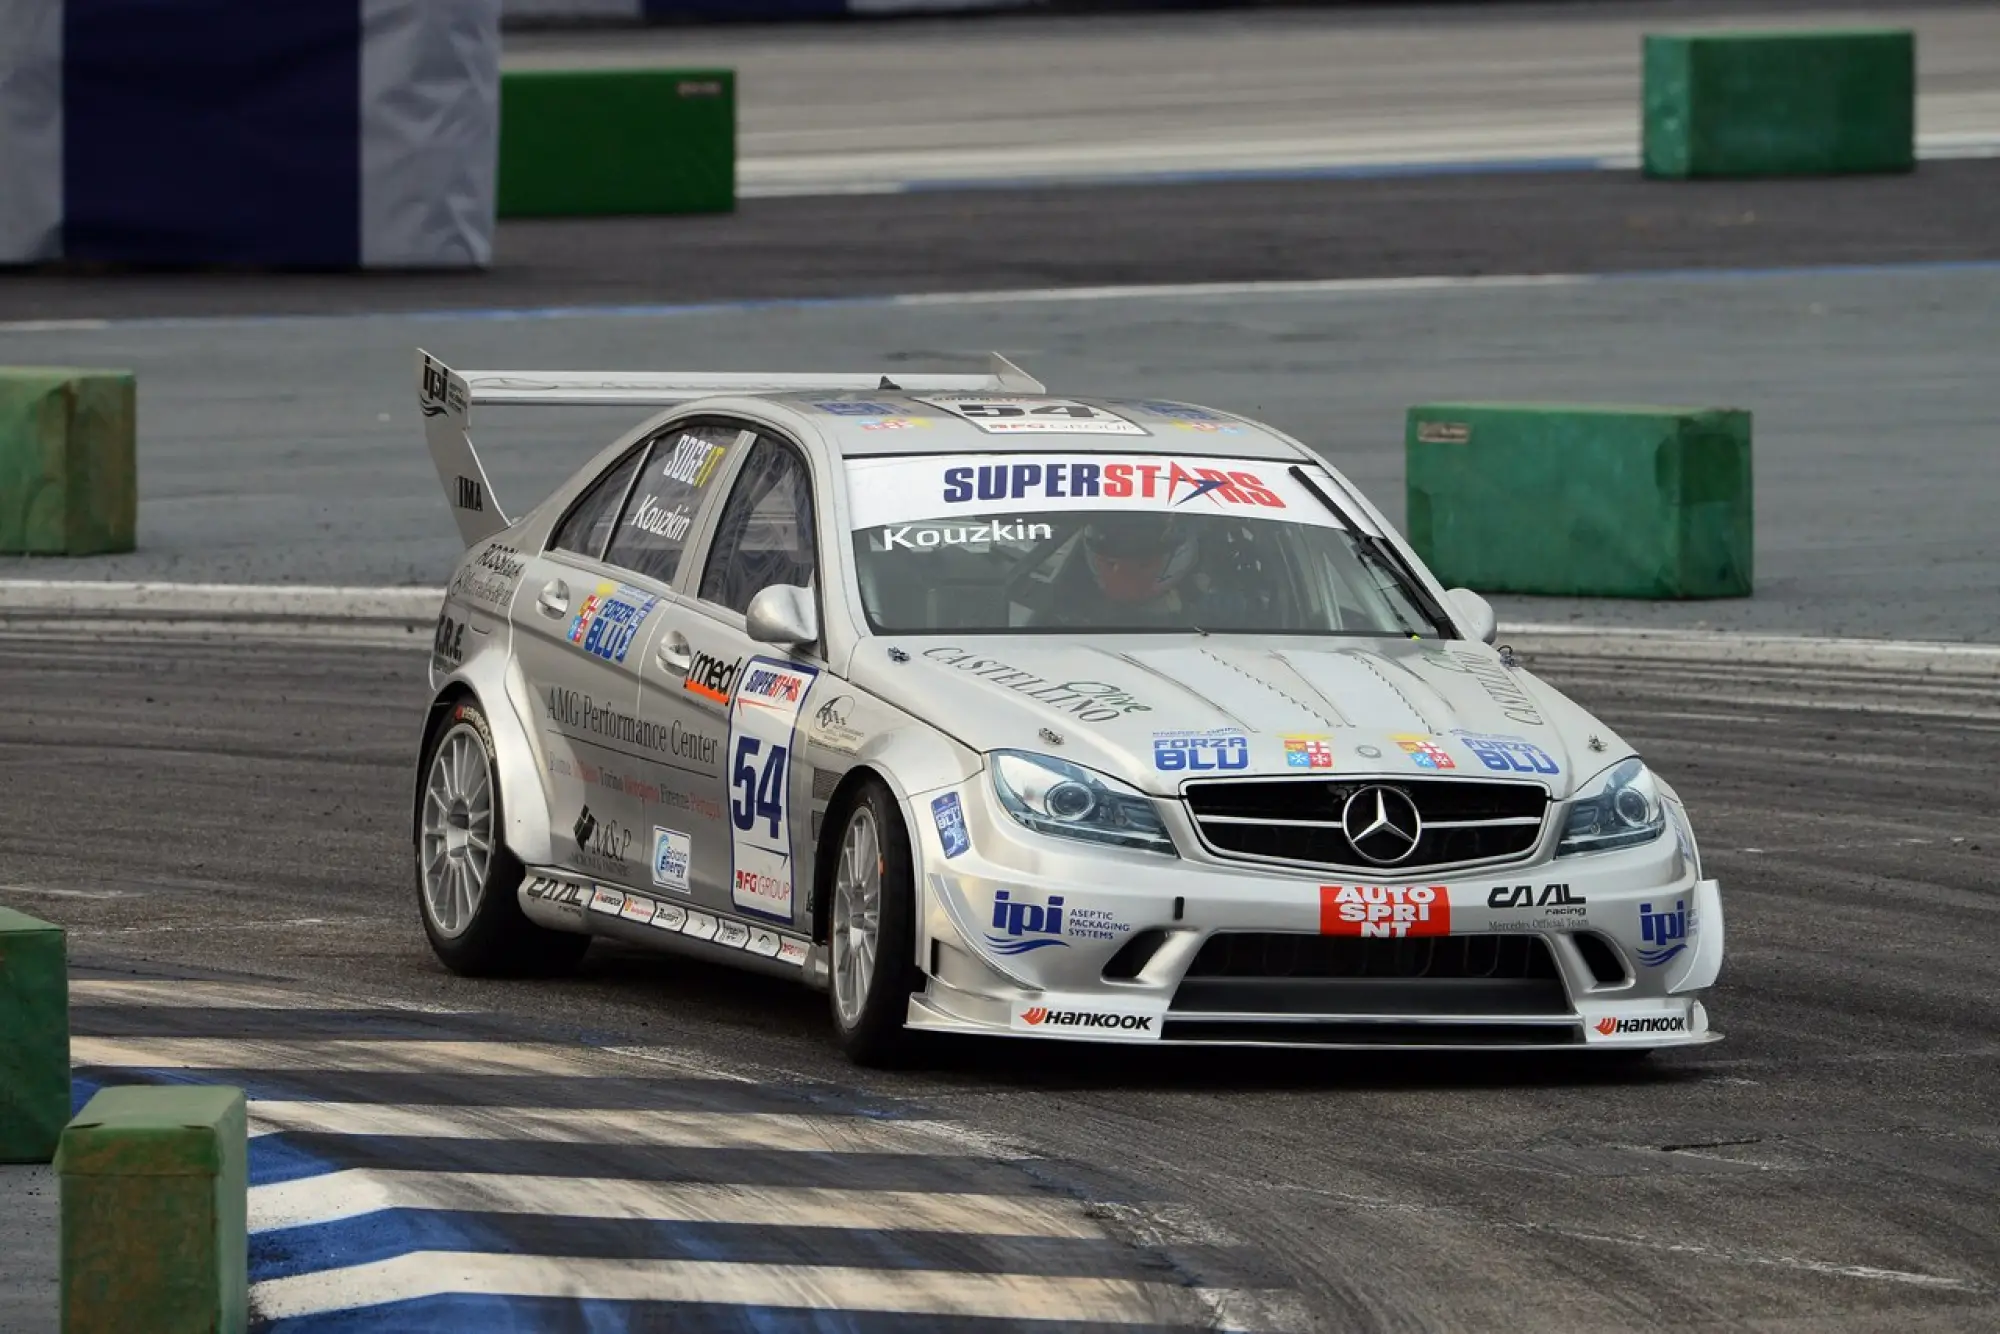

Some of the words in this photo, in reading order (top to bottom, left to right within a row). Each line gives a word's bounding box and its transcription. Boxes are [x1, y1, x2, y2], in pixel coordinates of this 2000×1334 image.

[958, 404, 1100, 418] 54
[943, 461, 1287, 510] SUPERSTARS
[630, 493, 691, 541] Kouzkin
[882, 518, 1053, 552] Kouzkin
[922, 647, 1121, 723] CASTELLINO
[547, 686, 579, 727] AMG
[582, 695, 667, 752] Performance
[671, 720, 718, 765] Center
[1154, 736, 1248, 749] FORZA
[1154, 748, 1249, 771] BLU
[1473, 749, 1560, 775] BLU
[732, 735, 787, 840] 54
[1333, 885, 1436, 903] AUTO
[1487, 884, 1587, 908] CAAL
[991, 889, 1065, 936] ipi
[1069, 908, 1114, 921] ASEPTIC
[1338, 903, 1430, 921] SPRI
[1544, 907, 1587, 916] racing
[1639, 900, 1686, 946] ipi
[1069, 919, 1131, 932] PACKAGING
[1069, 928, 1114, 941] SYSTEMS
[1360, 922, 1412, 938] NT
